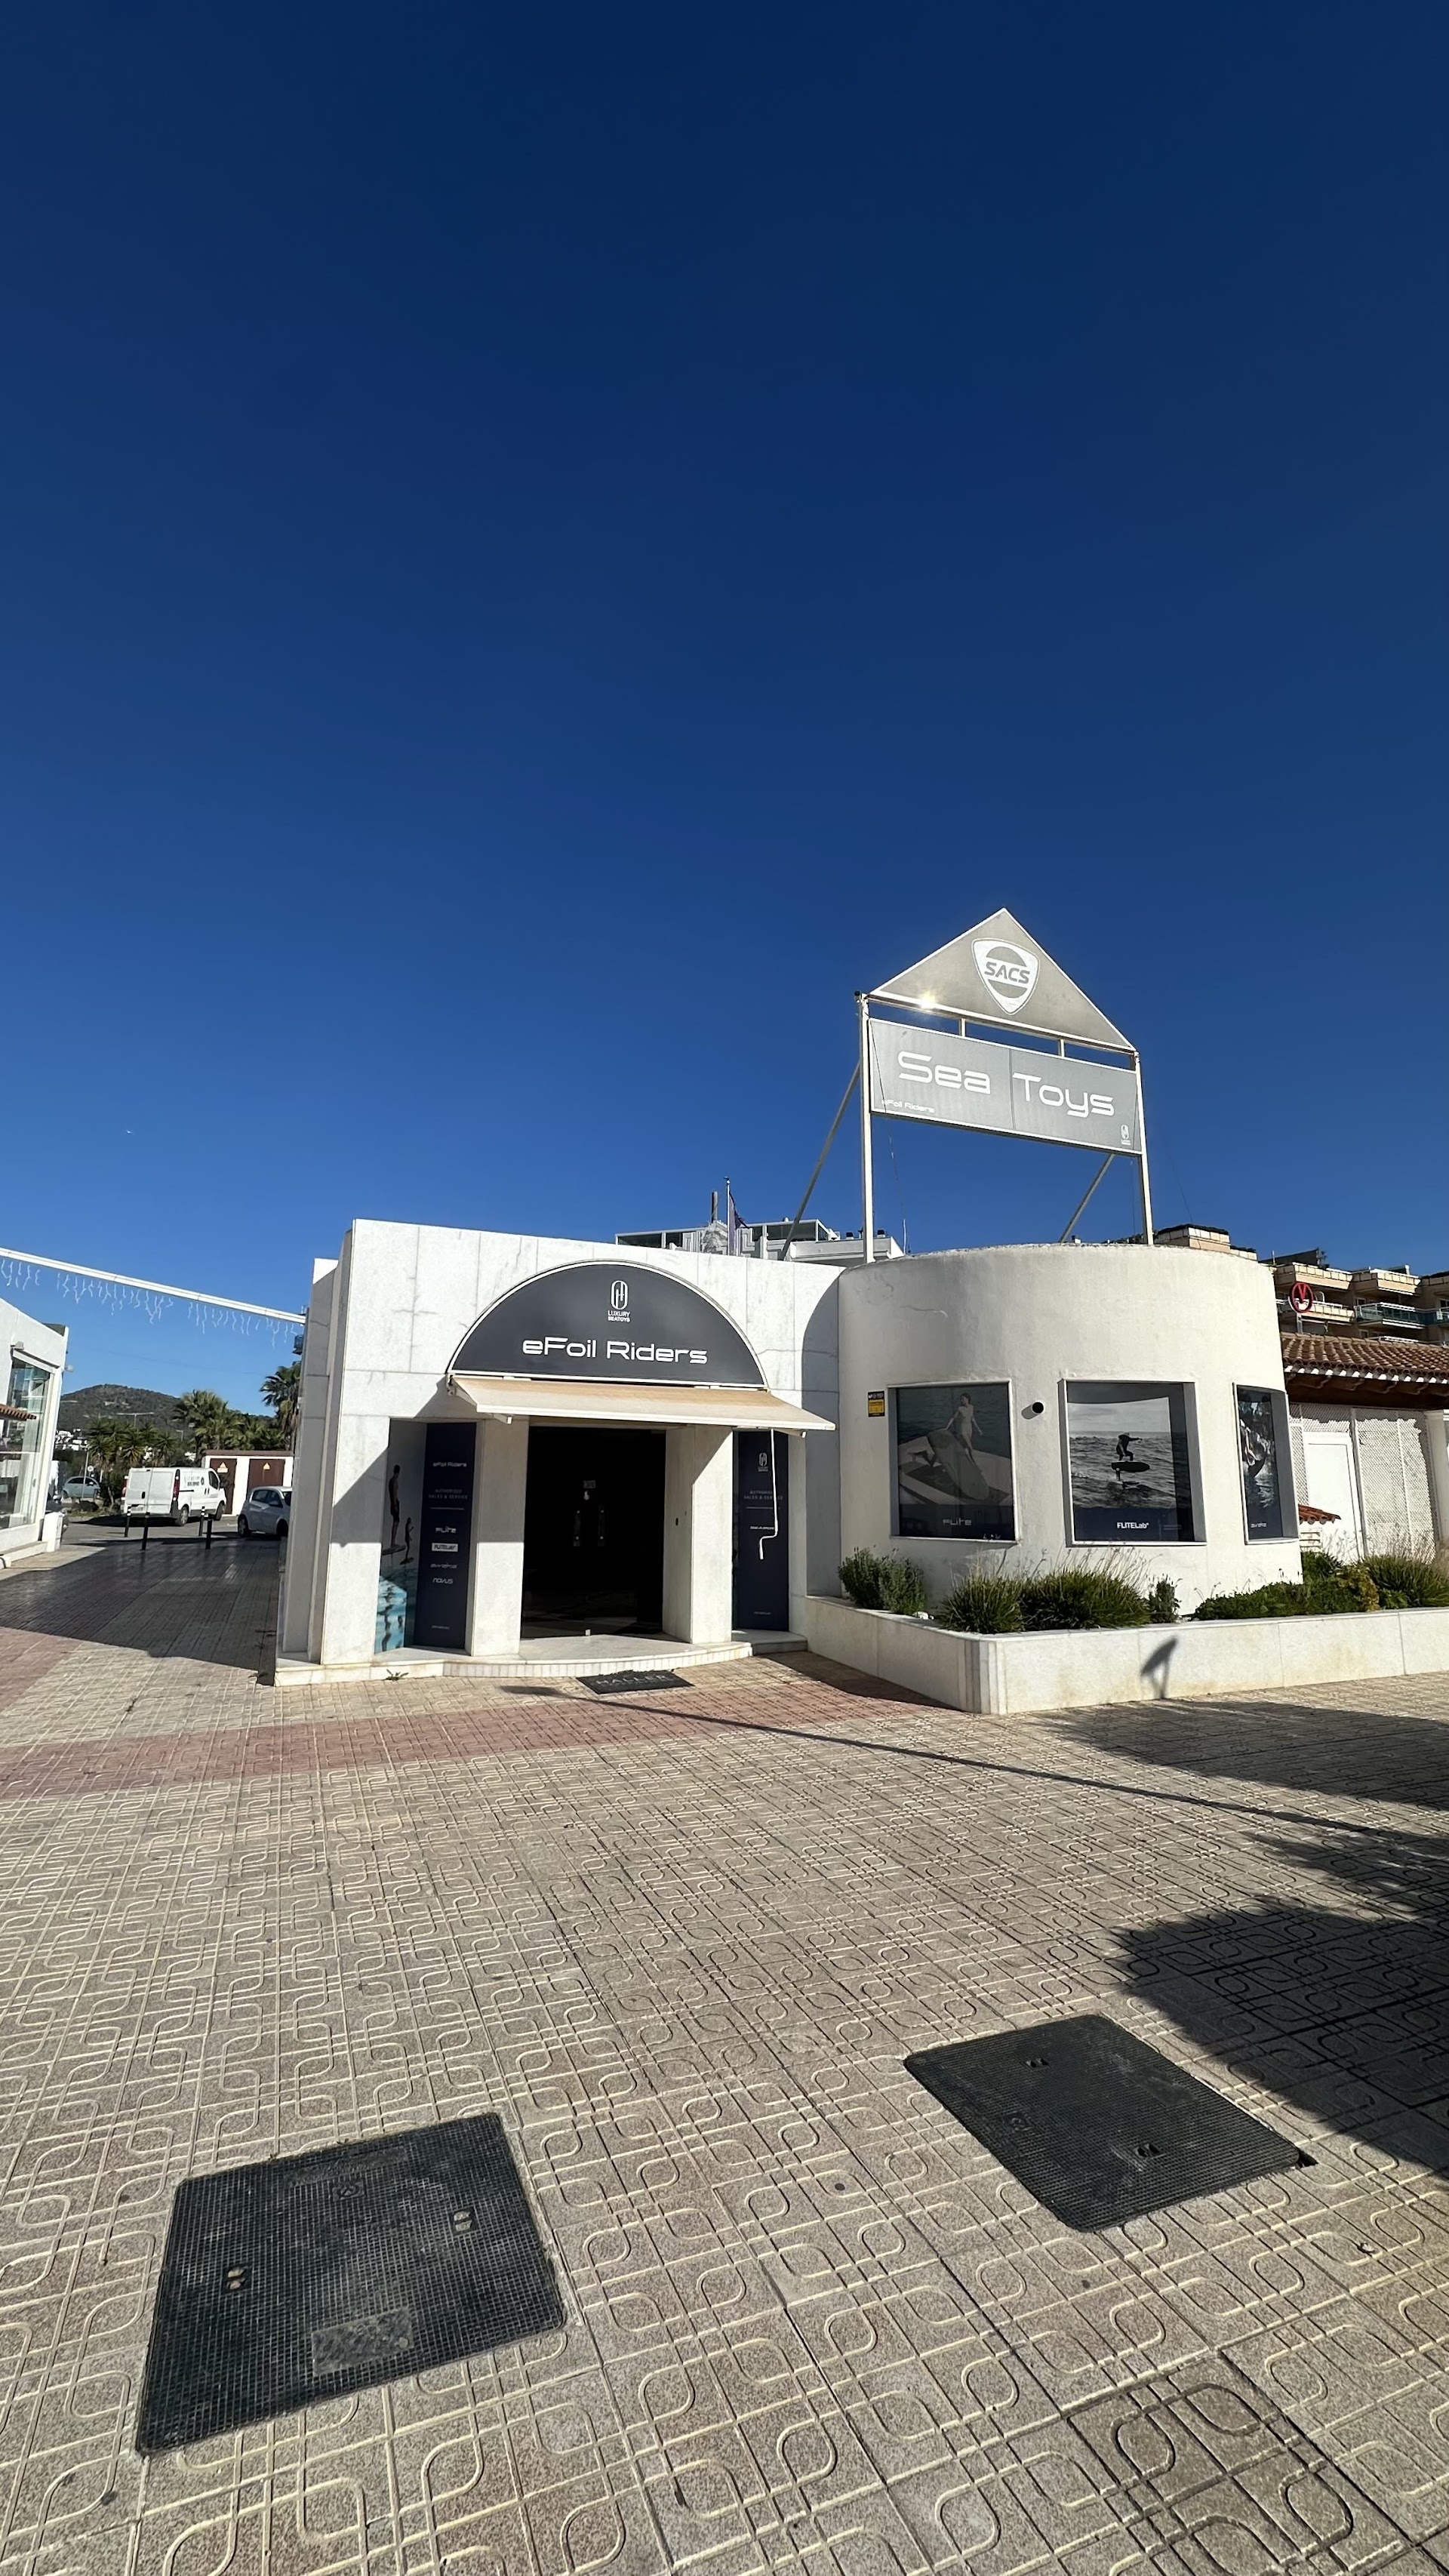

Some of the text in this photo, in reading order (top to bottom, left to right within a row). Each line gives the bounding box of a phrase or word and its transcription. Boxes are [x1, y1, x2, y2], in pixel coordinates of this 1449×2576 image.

[984, 962, 1031, 984] SACS
[897, 1051, 1115, 1118] Sea Toys
[881, 1099, 935, 1113] eFoil Riders
[608, 1310, 630, 1318] LUXURY
[522, 1337, 708, 1365] eFoil Riders
